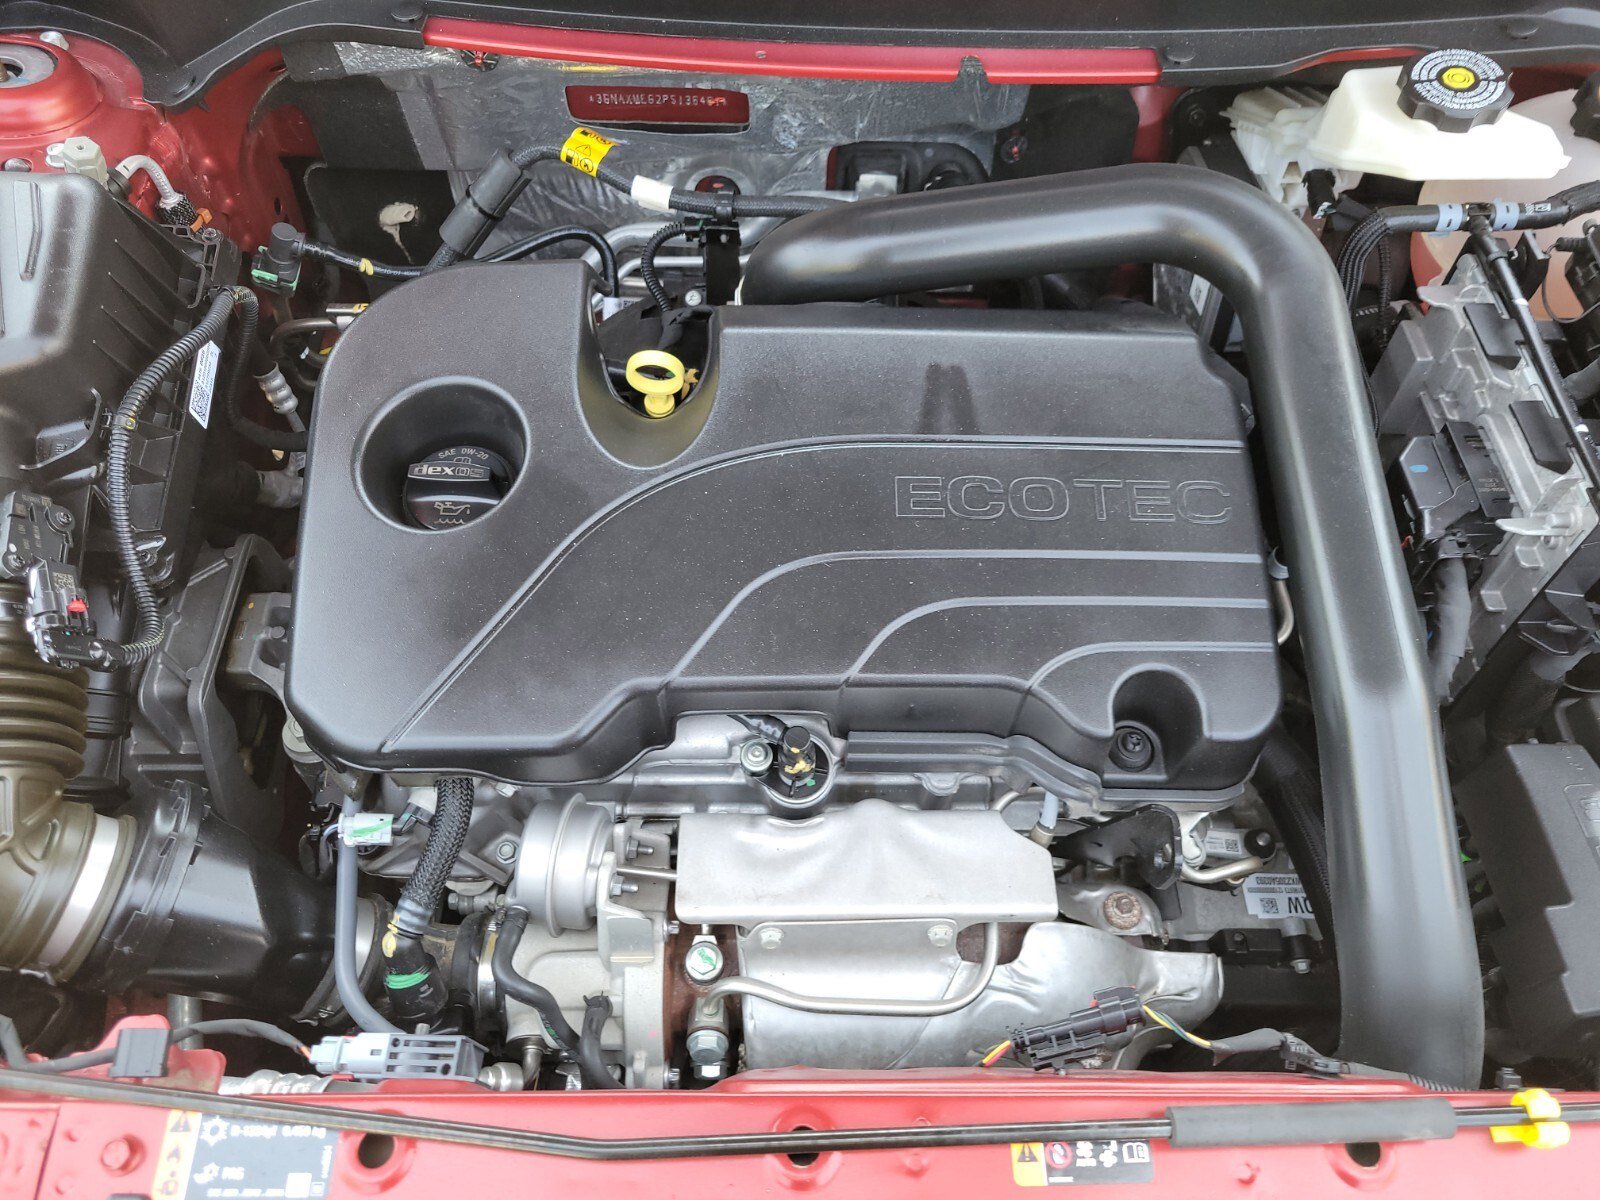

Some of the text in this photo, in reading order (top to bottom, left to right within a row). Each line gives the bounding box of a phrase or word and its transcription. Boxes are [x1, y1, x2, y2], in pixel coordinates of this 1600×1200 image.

[438, 448, 489, 460] SAE 0W-20
[413, 464, 485, 478] dexos
[894, 476, 1232, 525] ECOTEC
